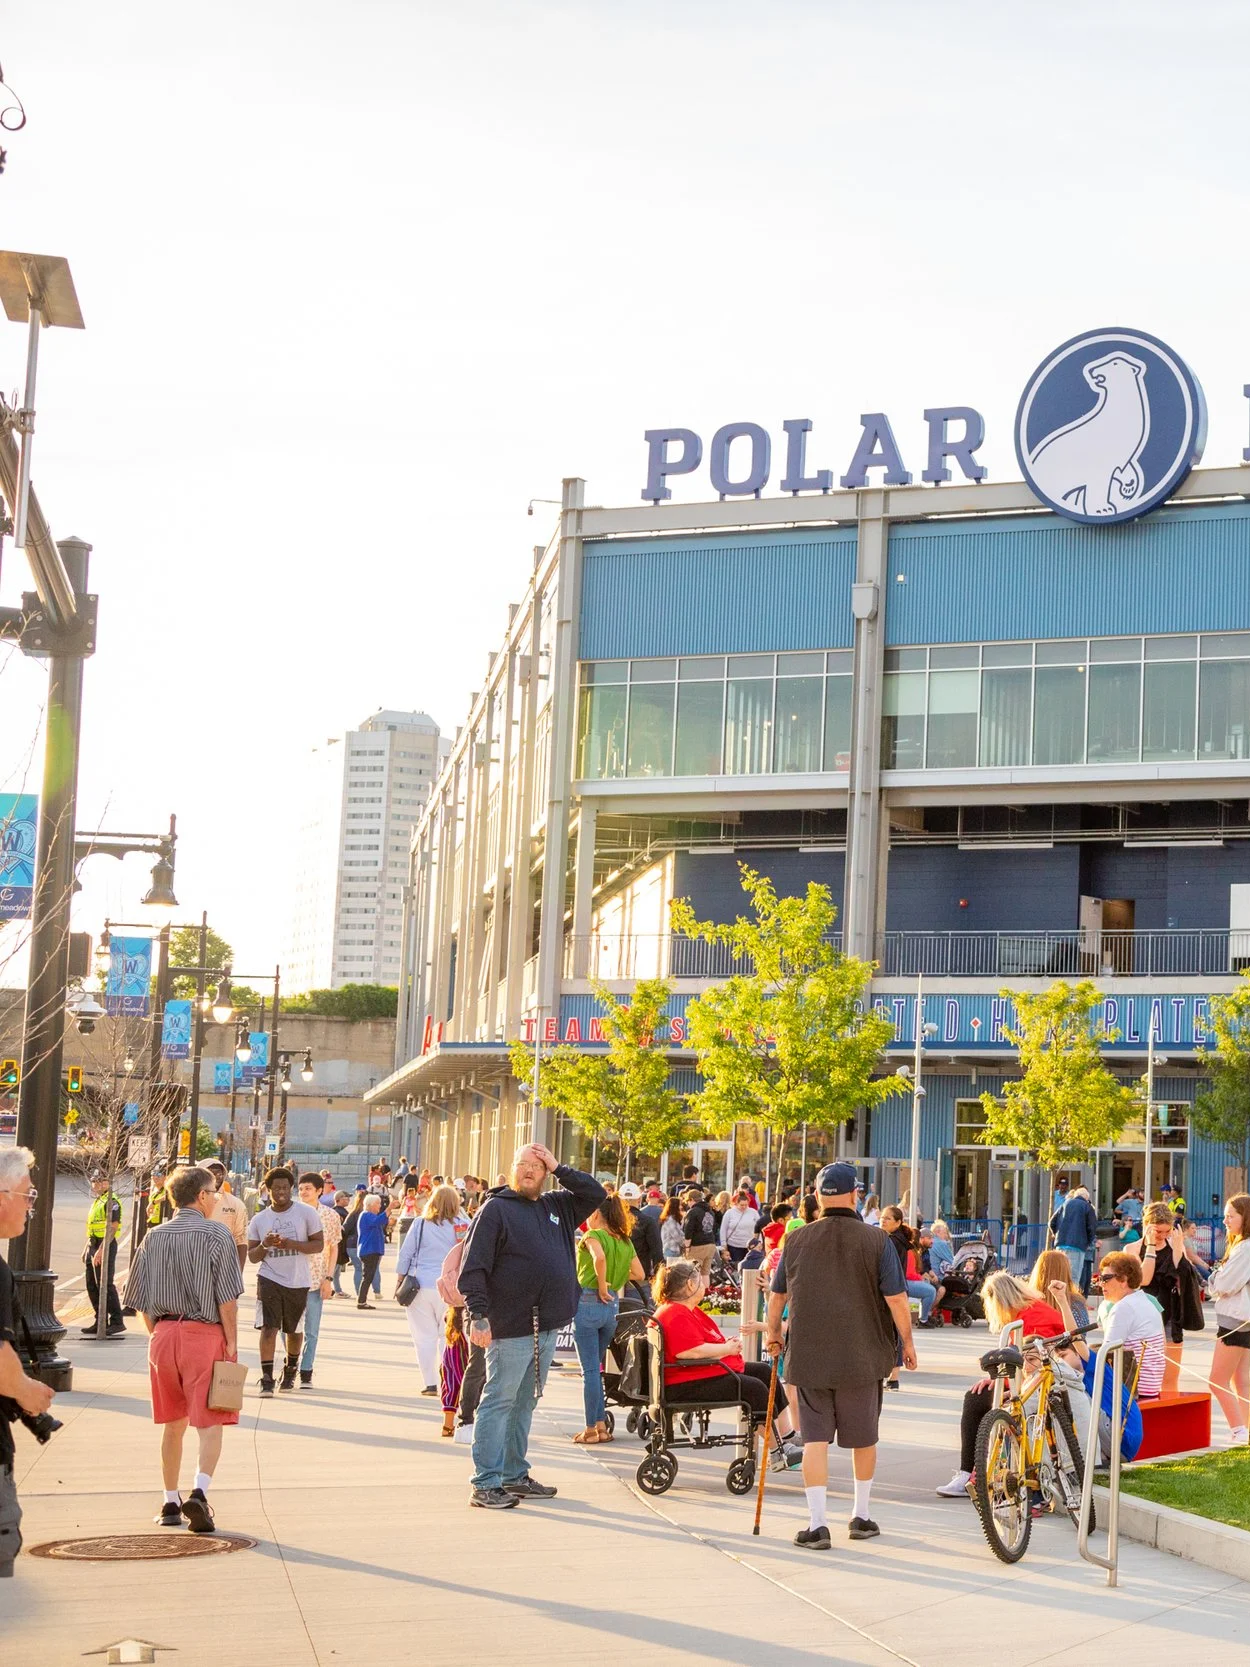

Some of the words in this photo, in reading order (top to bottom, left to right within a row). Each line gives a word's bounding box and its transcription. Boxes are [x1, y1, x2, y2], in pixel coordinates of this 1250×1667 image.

[641, 406, 987, 502] POLAR
[944, 998, 960, 1042] D
[1103, 998, 1207, 1042] PLATE
